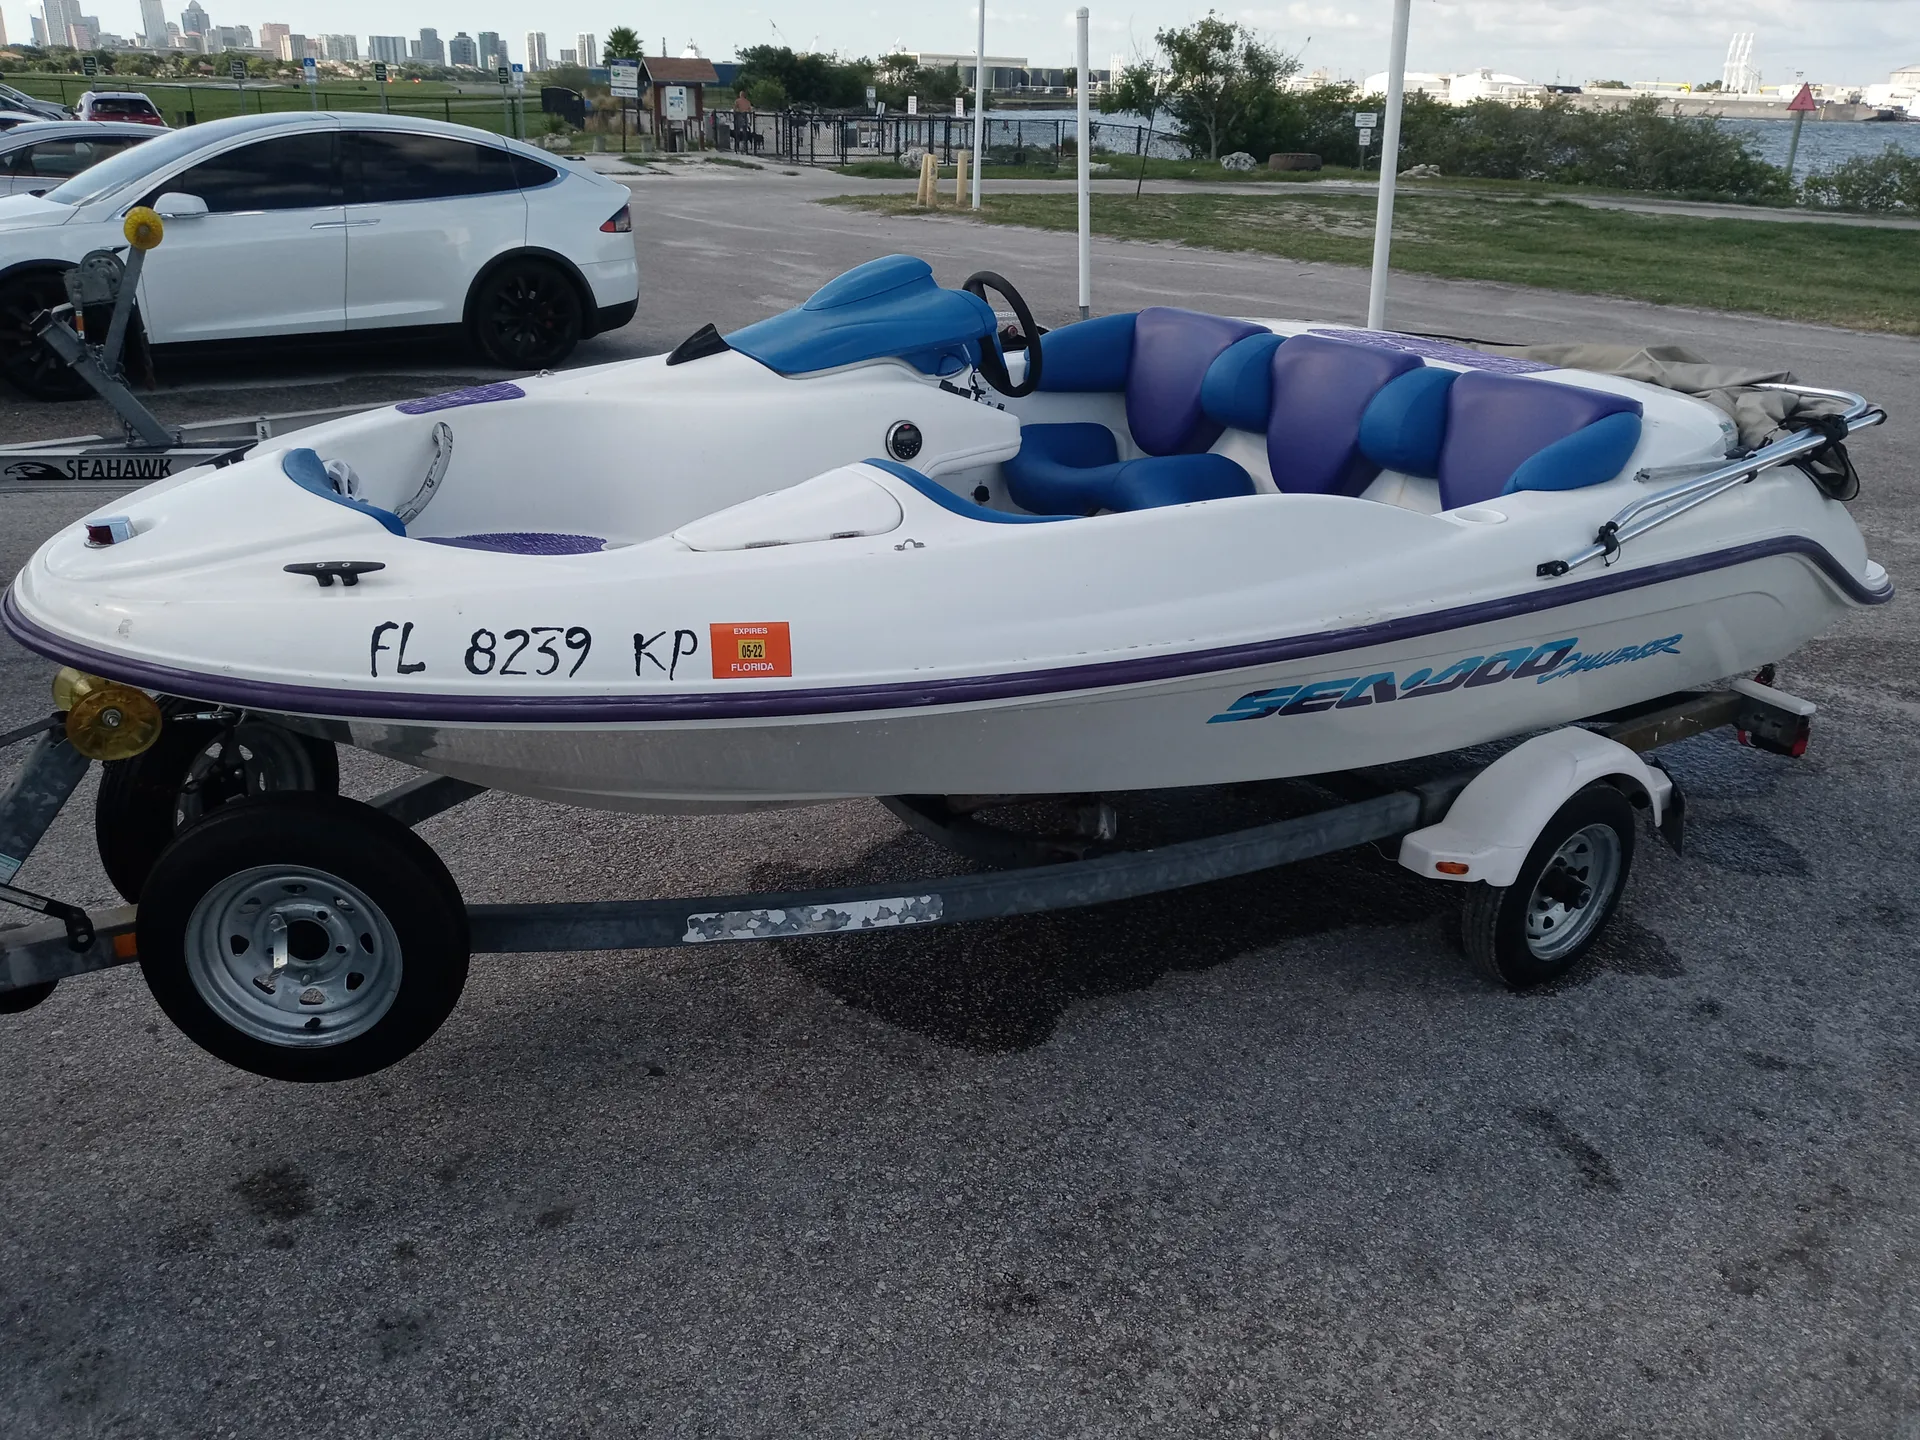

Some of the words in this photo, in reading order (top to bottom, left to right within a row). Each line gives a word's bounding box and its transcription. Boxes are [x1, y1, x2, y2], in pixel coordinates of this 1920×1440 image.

[66, 459, 173, 480] SEAHAWK
[733, 627, 768, 635] EXPIRES
[371, 621, 426, 677] FL
[464, 626, 592, 678] 8239
[633, 629, 698, 681] KP
[741, 644, 763, 658] 05-22
[731, 662, 774, 672] FLORIDA
